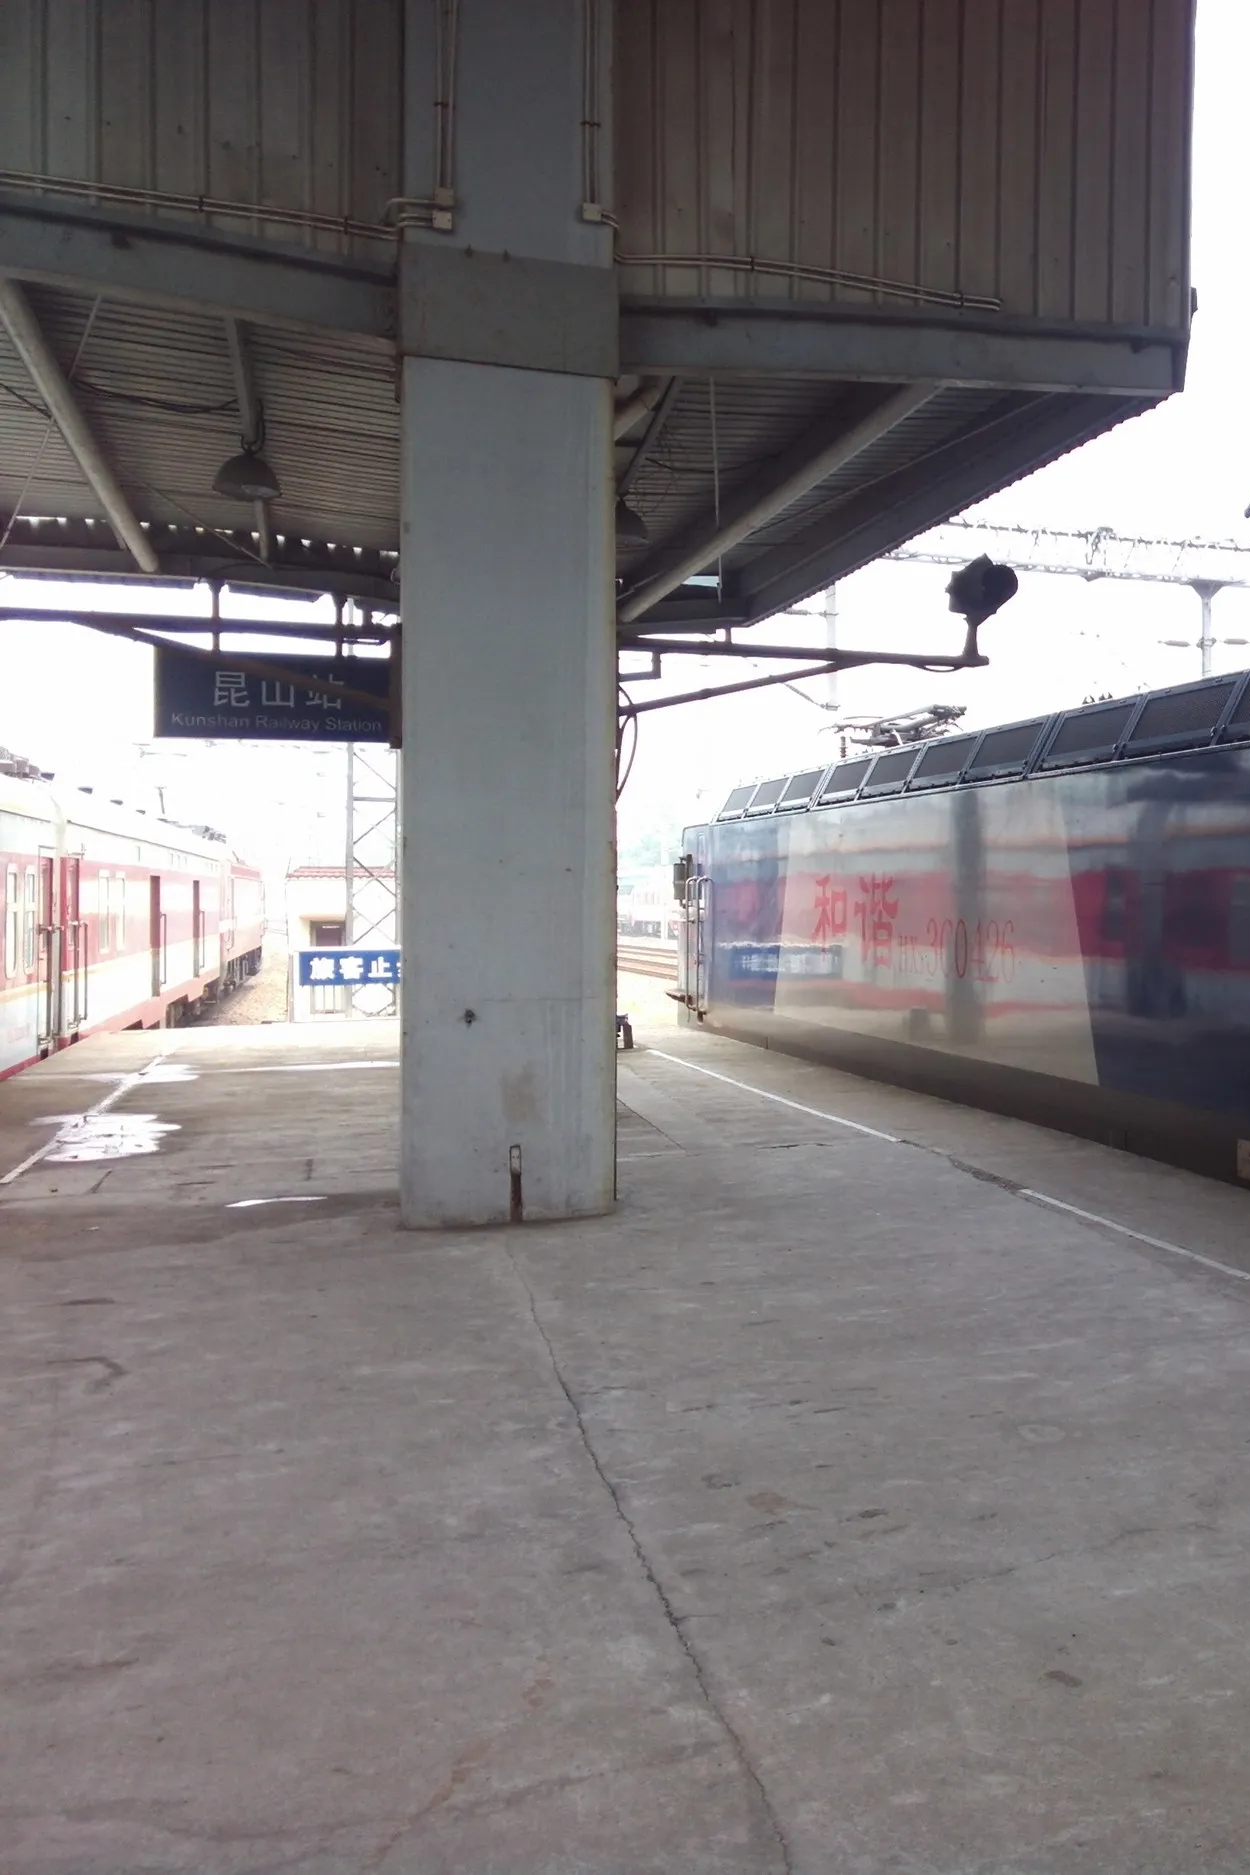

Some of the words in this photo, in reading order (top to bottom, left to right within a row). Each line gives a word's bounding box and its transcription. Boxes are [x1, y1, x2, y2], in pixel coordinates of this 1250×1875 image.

[213, 670, 345, 710] 昆山站
[171, 711, 250, 729] Kunshan
[255, 714, 320, 733] Railway
[325, 716, 382, 733] Station
[811, 872, 900, 970] 和谐
